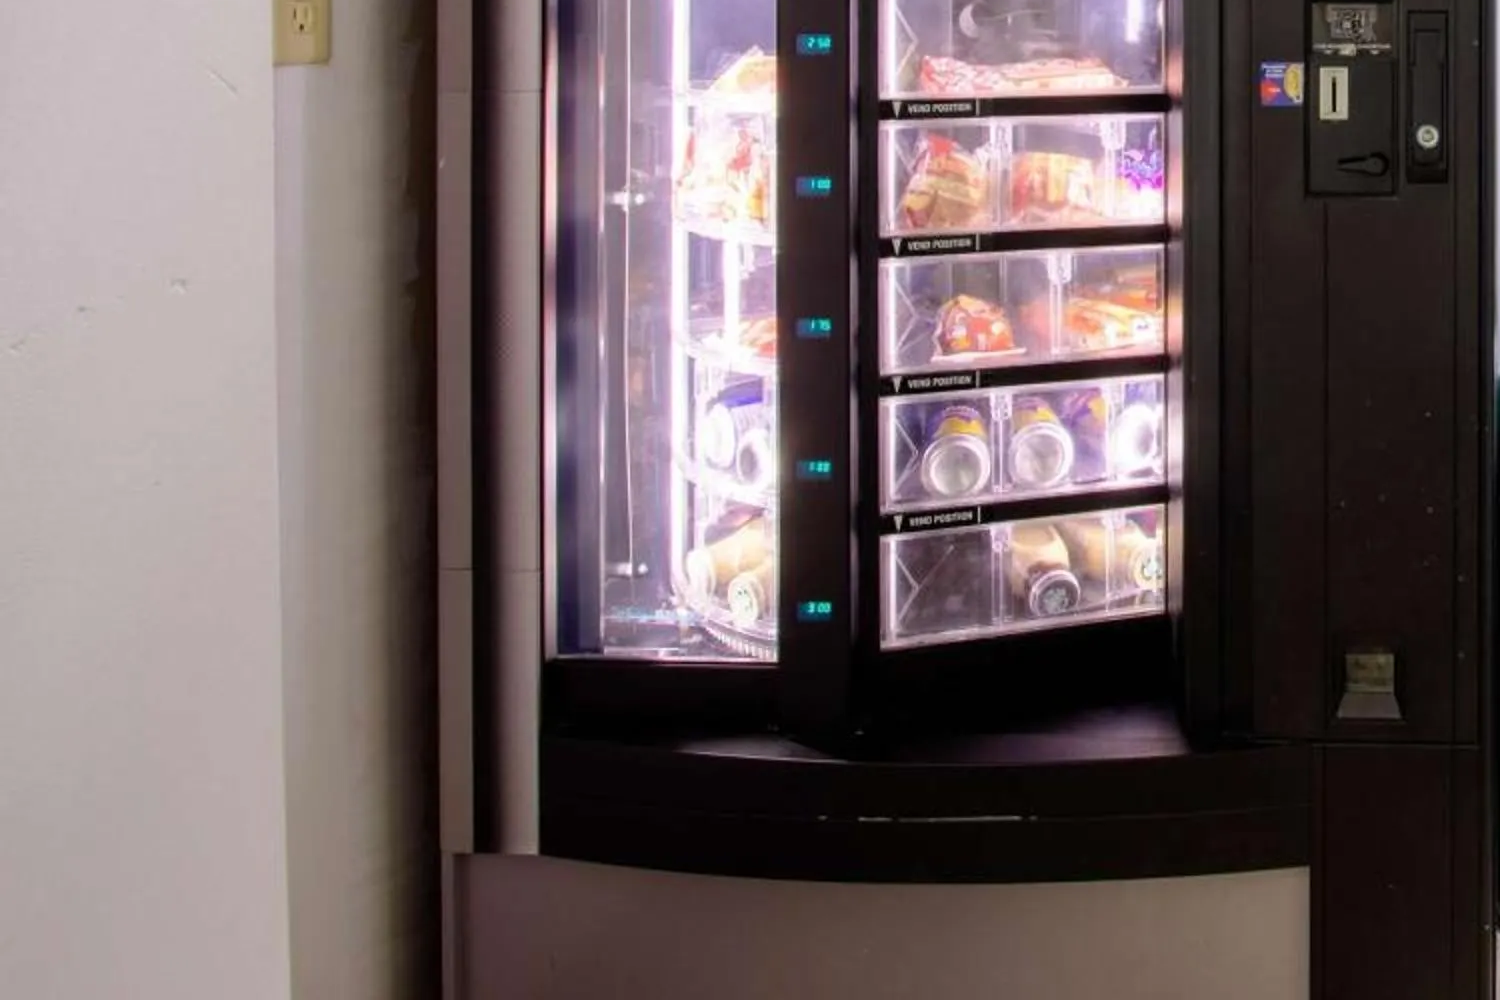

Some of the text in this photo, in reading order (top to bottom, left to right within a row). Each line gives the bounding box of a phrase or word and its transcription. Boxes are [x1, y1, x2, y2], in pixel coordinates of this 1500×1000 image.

[907, 102, 972, 114] VEND POSITION
[908, 238, 972, 251] VEND POSITION
[907, 375, 972, 389] VEND POSITION
[934, 511, 973, 524] POSITION
